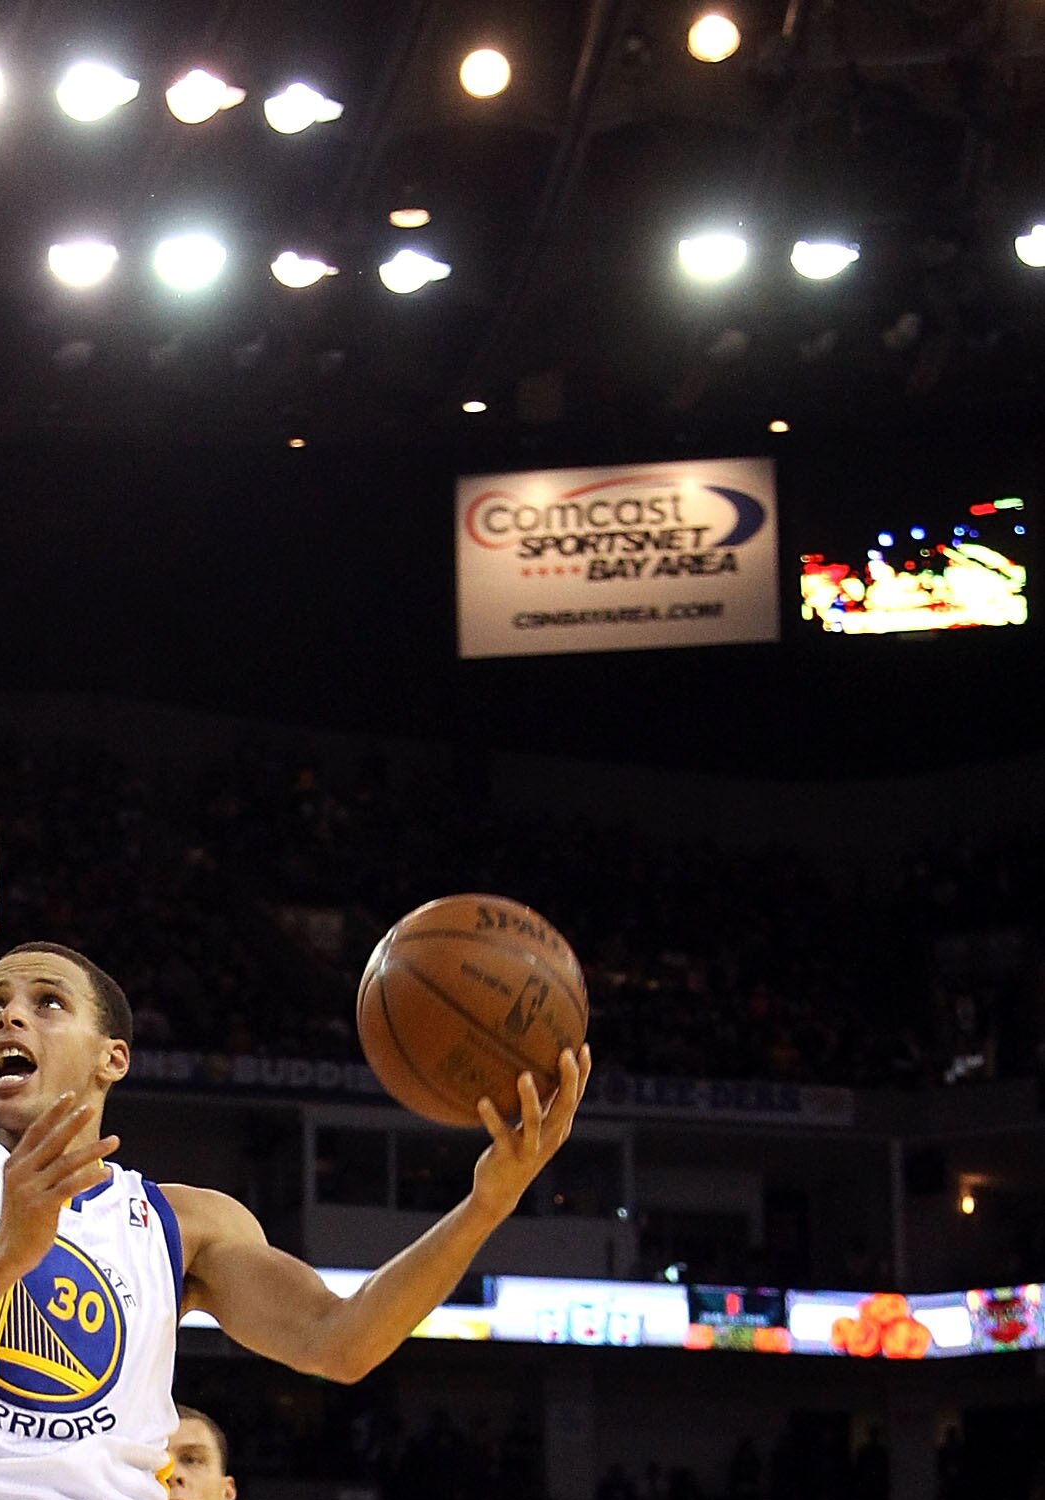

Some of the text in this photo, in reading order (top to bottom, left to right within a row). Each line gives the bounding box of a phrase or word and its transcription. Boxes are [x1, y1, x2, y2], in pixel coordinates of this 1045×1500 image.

[483, 491, 685, 534] comcast
[518, 526, 712, 560] SPORTSNET
[586, 550, 739, 582] BAY AREA
[46, 1277, 105, 1334] 30
